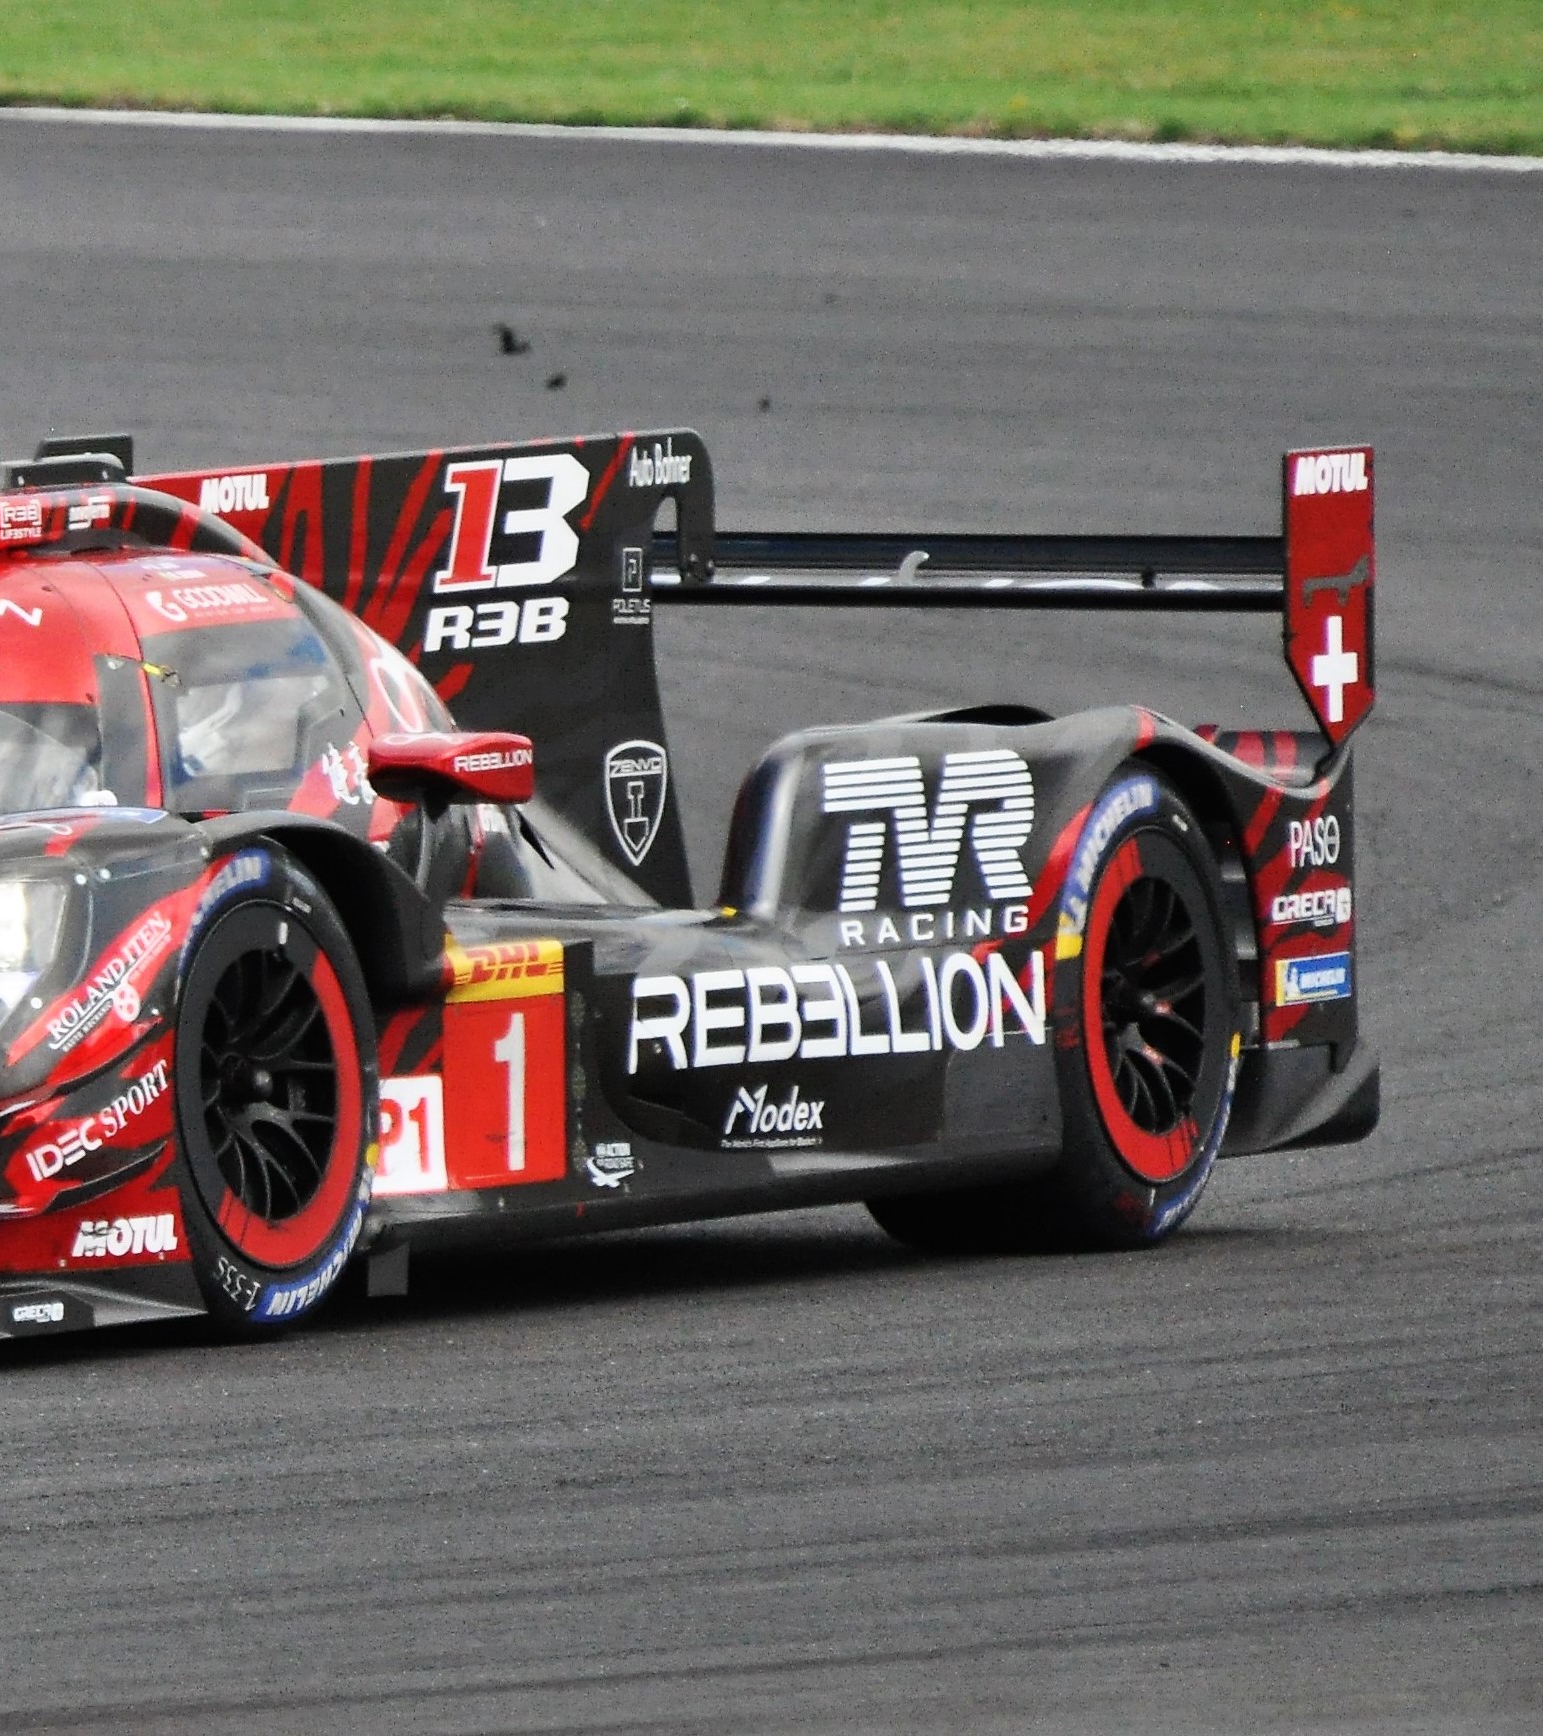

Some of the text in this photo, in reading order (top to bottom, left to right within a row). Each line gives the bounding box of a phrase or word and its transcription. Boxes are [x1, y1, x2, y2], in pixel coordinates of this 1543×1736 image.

[200, 474, 269, 514] MOTUL
[1295, 452, 1369, 495] MOTUL
[434, 454, 590, 593] 13
[424, 596, 569, 652] R3B
[454, 749, 534, 773] REBELLION
[610, 757, 663, 777] ZENVO
[823, 748, 1035, 912] TVR
[840, 905, 1030, 947] RACING
[46, 957, 126, 1041] ROLAND
[121, 911, 168, 964] ITEN
[465, 943, 549, 985] DHL
[628, 950, 1046, 1076] REBELLION
[494, 1012, 526, 1172] 1
[724, 1084, 825, 1135] Modex
[25, 1059, 168, 1182] IDEC SPORT
[378, 1096, 430, 1177] P1
[71, 1213, 178, 1258] MOTUL
